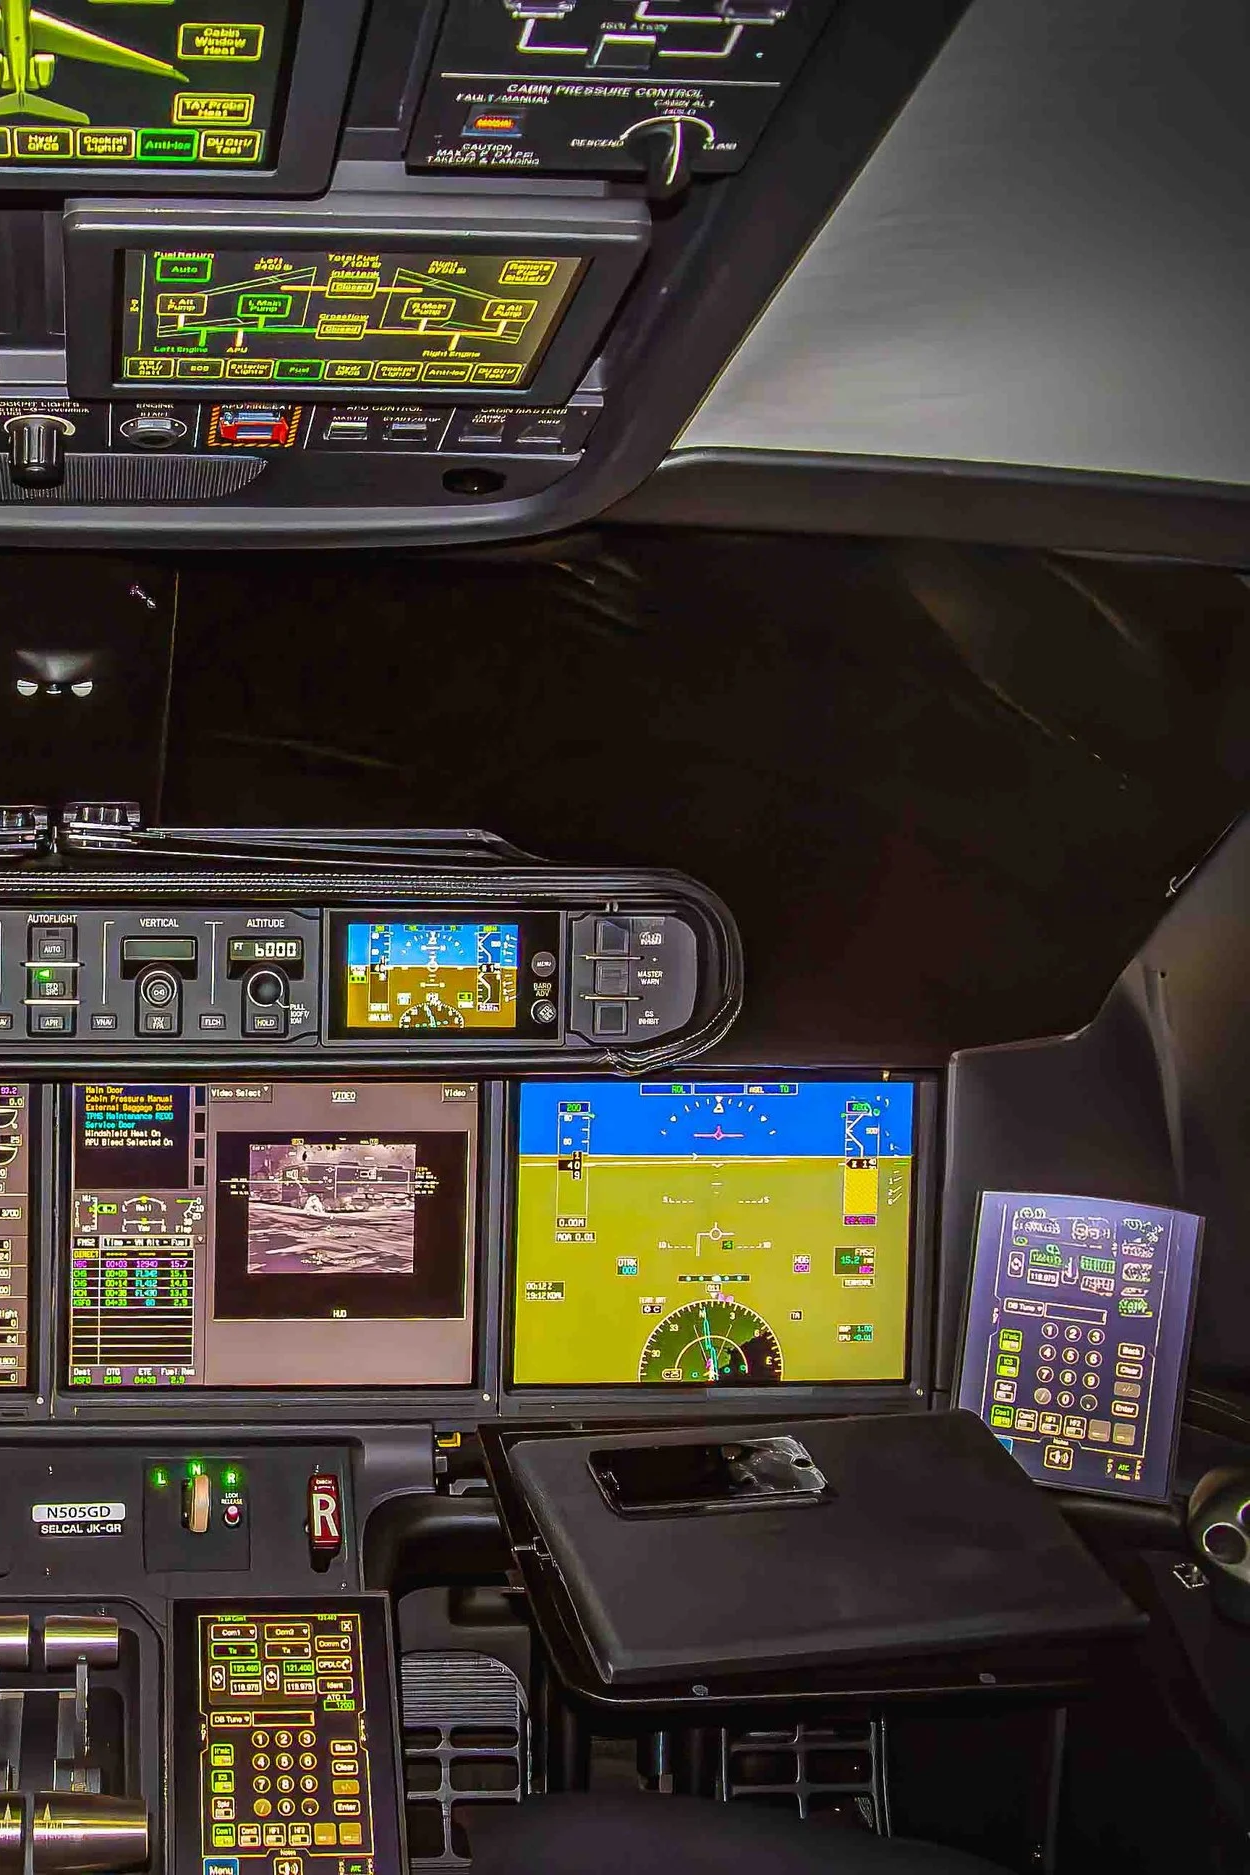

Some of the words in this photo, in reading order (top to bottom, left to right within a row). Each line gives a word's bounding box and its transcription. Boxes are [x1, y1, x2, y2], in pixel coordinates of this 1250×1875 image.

[635, 86, 704, 99] CONTROL
[28, 914, 78, 924] AUTOFLIGHT
[140, 919, 178, 927] VERTICAL
[247, 919, 284, 928] ALTITUDE
[641, 977, 660, 985] WARN
[645, 1010, 654, 1018] GS
[86, 1086, 104, 1094] Main
[106, 1086, 123, 1094] Door
[212, 1089, 234, 1097] Video
[236, 1089, 261, 1097] Select
[445, 1089, 467, 1097] Video
[110, 1095, 145, 1103] Pressure
[332, 1091, 355, 1100] VIDEO
[123, 1104, 152, 1112] Baggage
[164, 1139, 173, 1147] On
[77, 1238, 95, 1246] FMS2
[333, 1310, 347, 1318] HUD
[1070, 1329, 1076, 1338] 2
[192, 1464, 201, 1474] N
[158, 1472, 166, 1484] L
[228, 1472, 235, 1483] R
[47, 1506, 110, 1518] N505GD
[312, 1493, 339, 1536] R
[41, 1525, 83, 1534] SELCAL
[87, 1524, 121, 1533] JK-GR
[258, 1735, 263, 1744] 1
[280, 1735, 287, 1743] 2
[304, 1734, 311, 1744] 3
[259, 1780, 265, 1789] 7
[282, 1780, 289, 1789] 8
[283, 1803, 290, 1812] 0
[337, 1803, 356, 1811] Enter
